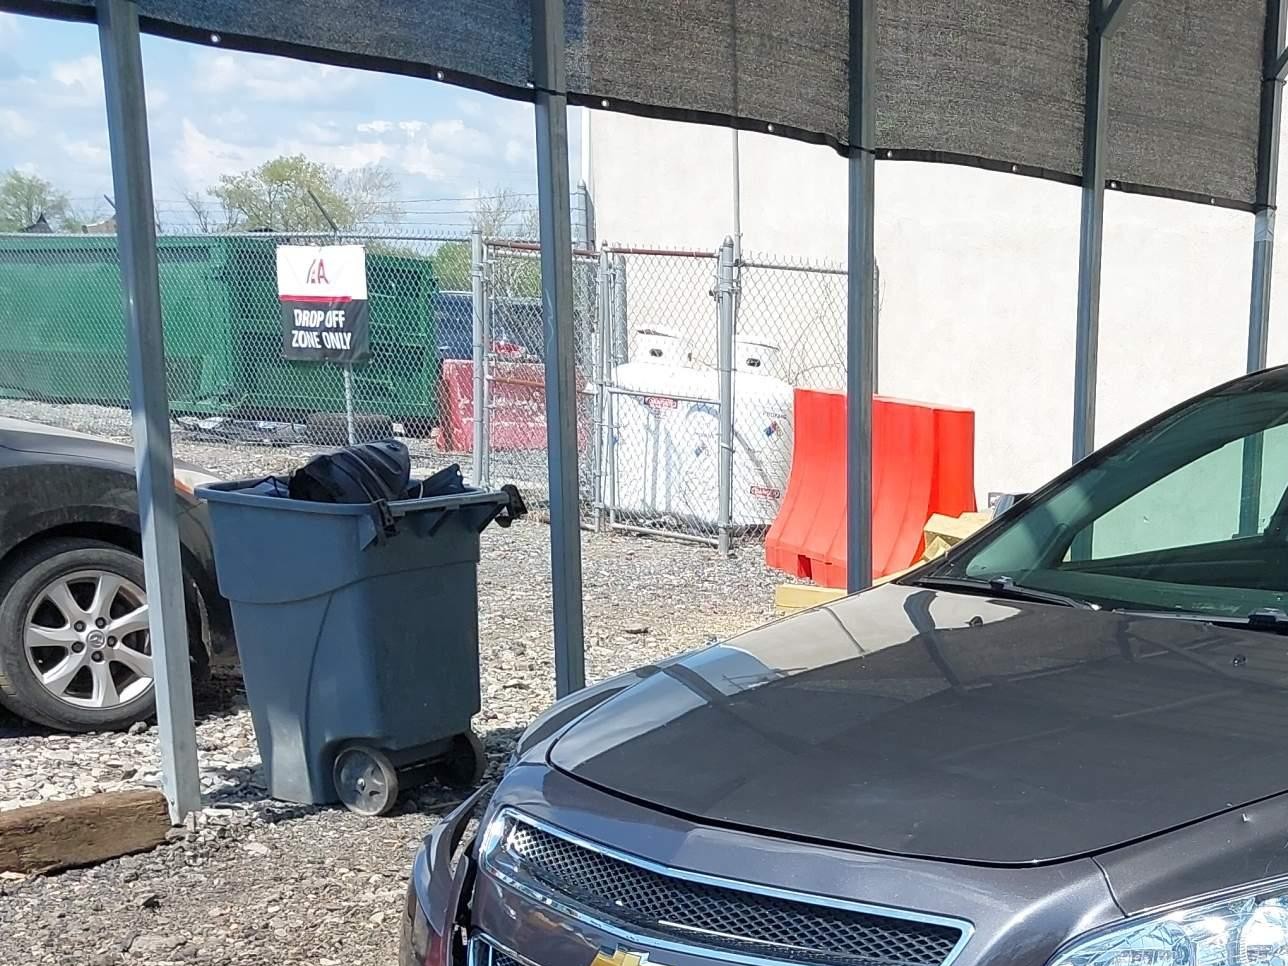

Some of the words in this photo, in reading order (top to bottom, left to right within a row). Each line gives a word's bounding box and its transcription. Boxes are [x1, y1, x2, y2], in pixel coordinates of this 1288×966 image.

[293, 308, 325, 328] DROP
[325, 310, 346, 328] OFF
[291, 330, 322, 349] ZONE
[322, 332, 351, 350] ONLY
